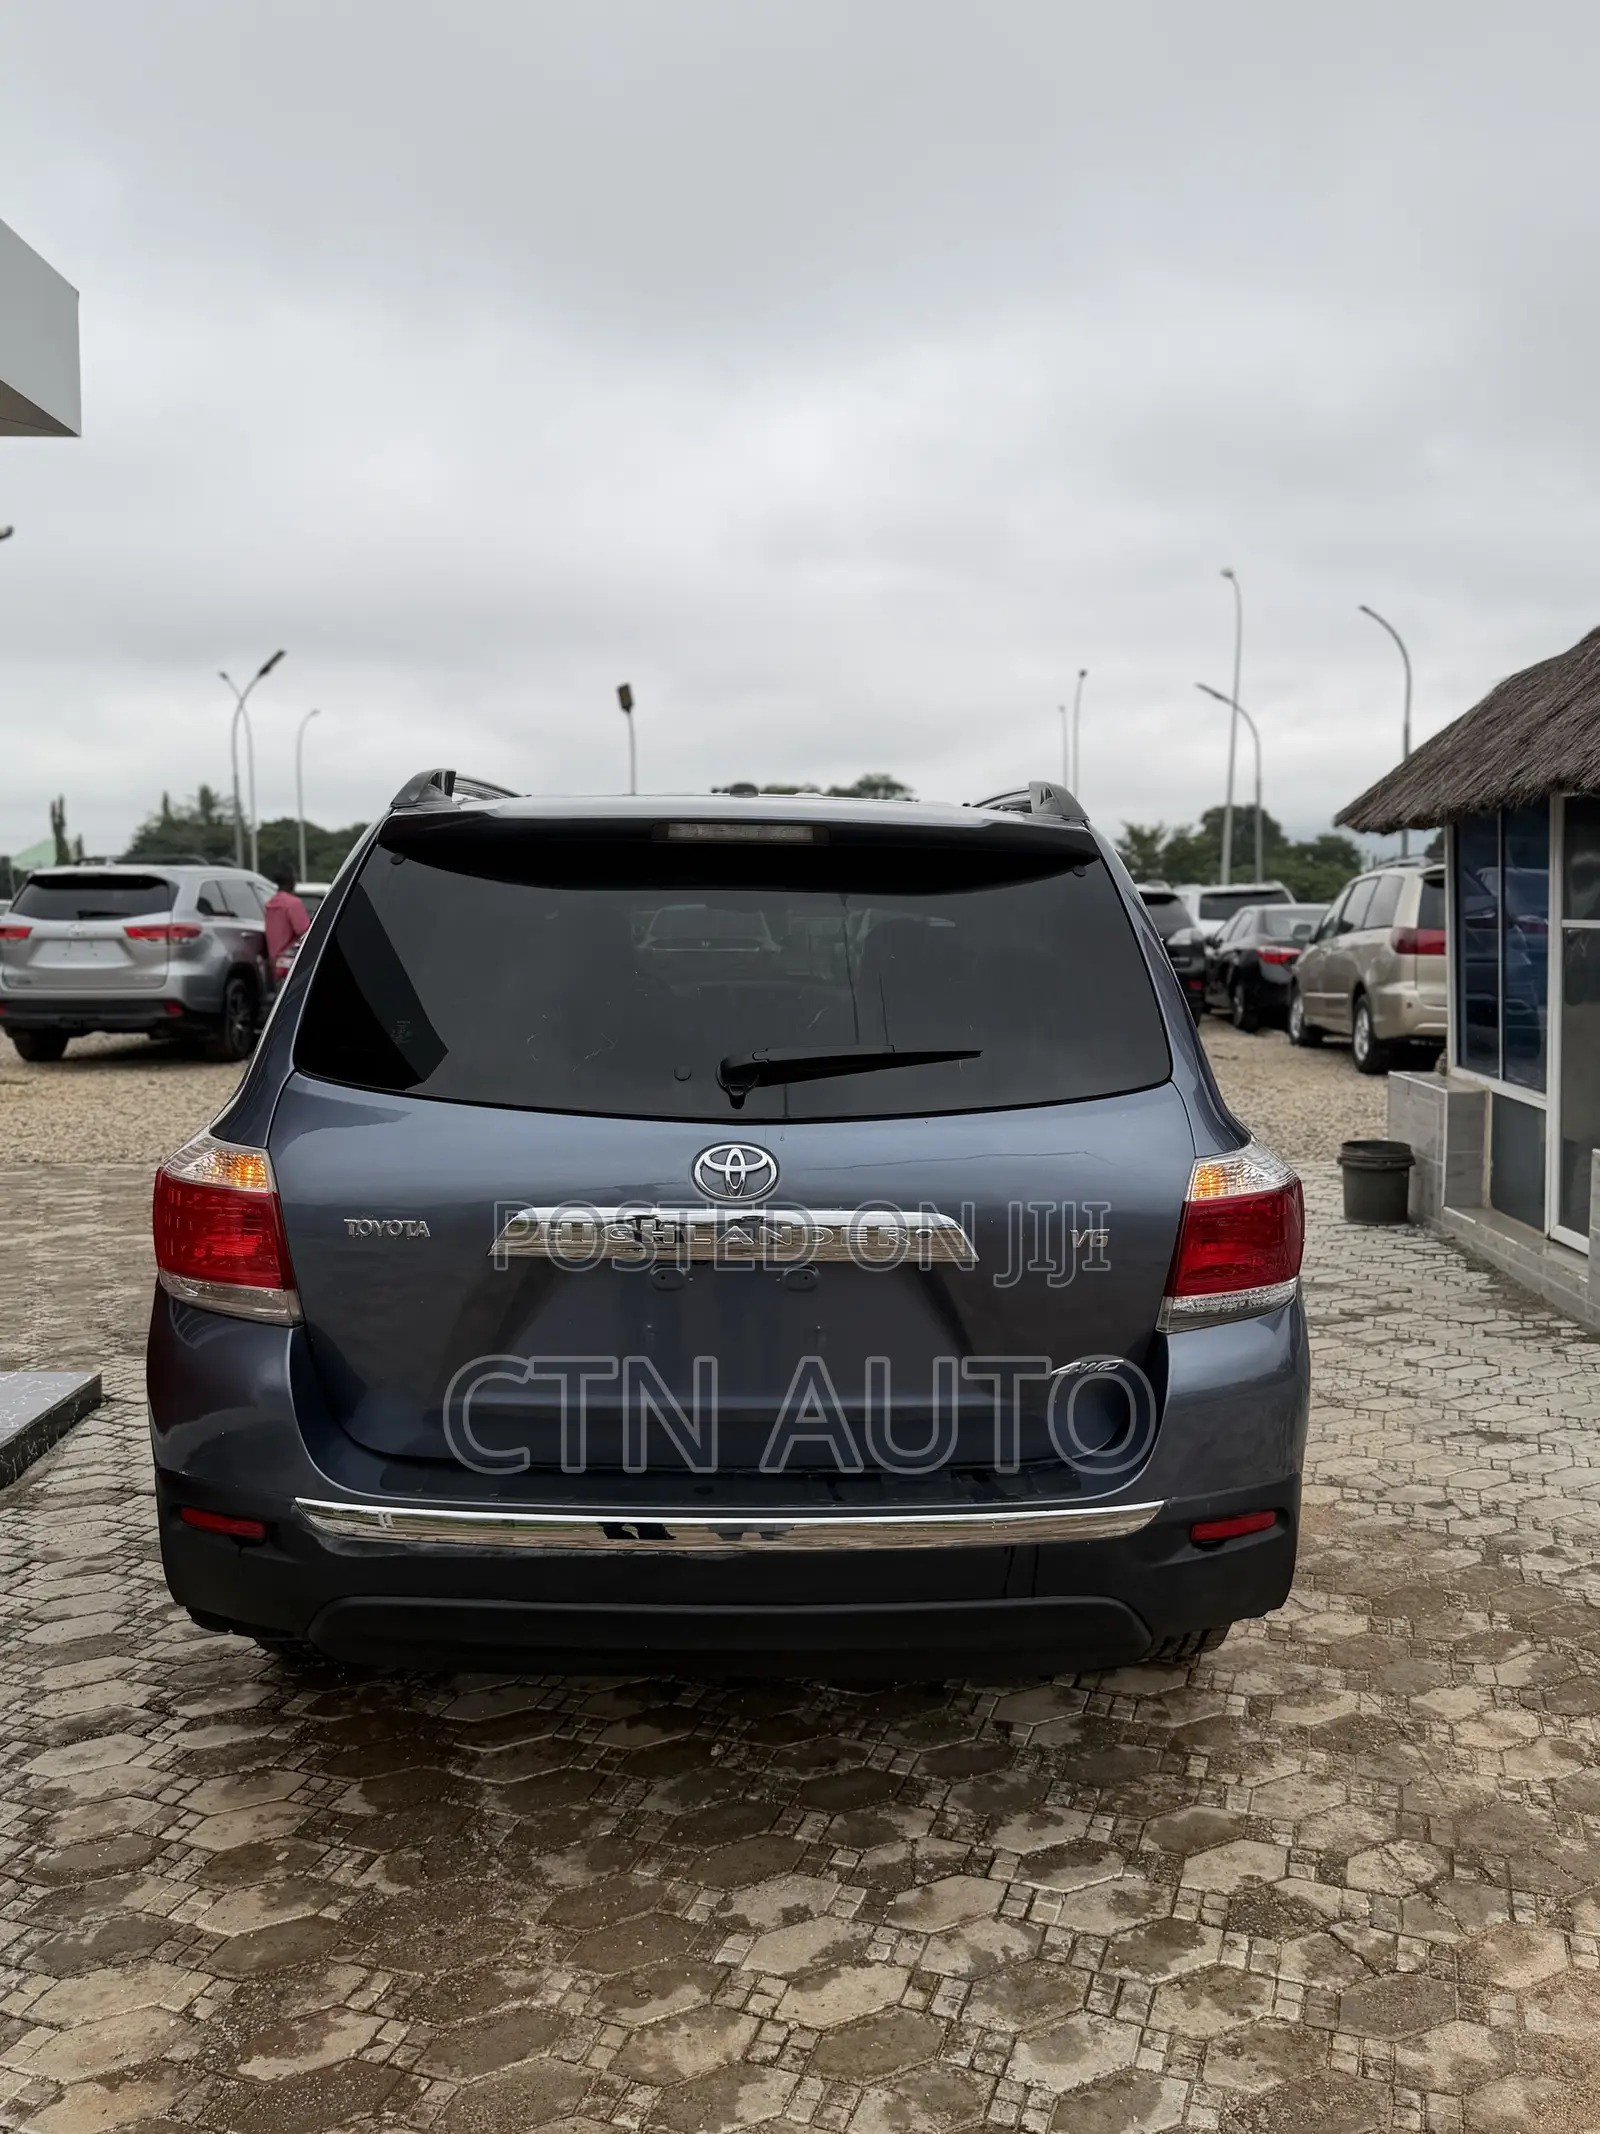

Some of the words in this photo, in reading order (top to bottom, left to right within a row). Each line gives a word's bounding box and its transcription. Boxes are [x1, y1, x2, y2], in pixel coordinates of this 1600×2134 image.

[343, 1218, 431, 1237] TOYOTA
[539, 1221, 911, 1246] HIGHLANDER
[1070, 1228, 1110, 1248] V6
